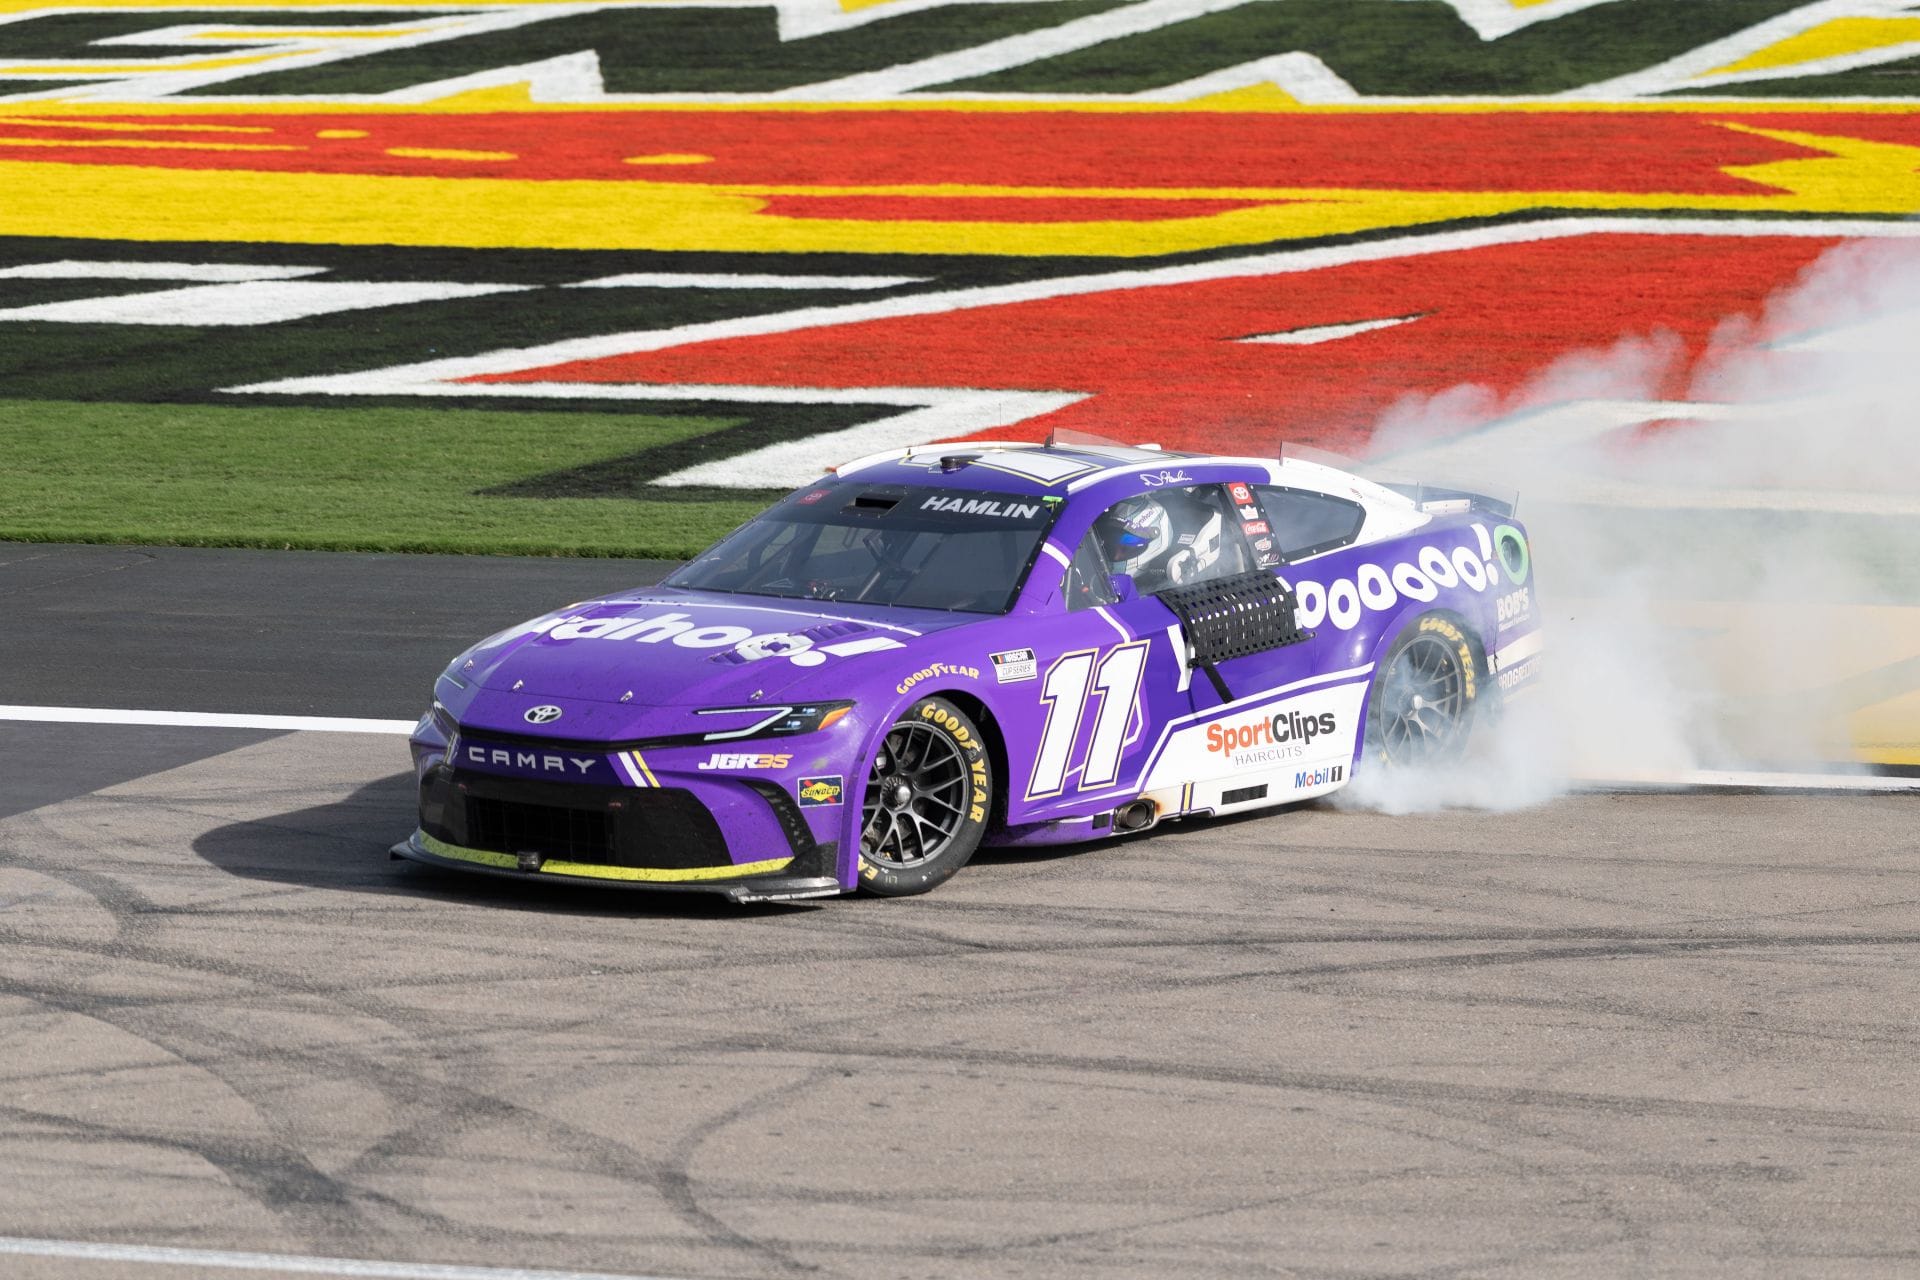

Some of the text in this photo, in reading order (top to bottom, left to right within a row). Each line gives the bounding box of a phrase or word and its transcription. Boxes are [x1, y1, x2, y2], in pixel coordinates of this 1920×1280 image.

[920, 496, 1040, 519] HAMLIN
[896, 662, 980, 695] GOODYEAR
[1024, 639, 1151, 802] 11
[468, 746, 597, 775] CAMRY
[698, 753, 794, 770] JGR35
[1234, 745, 1303, 766] HAIRCUTS
[1294, 767, 1329, 789] Mobil
[803, 786, 839, 797] SUNOCO
